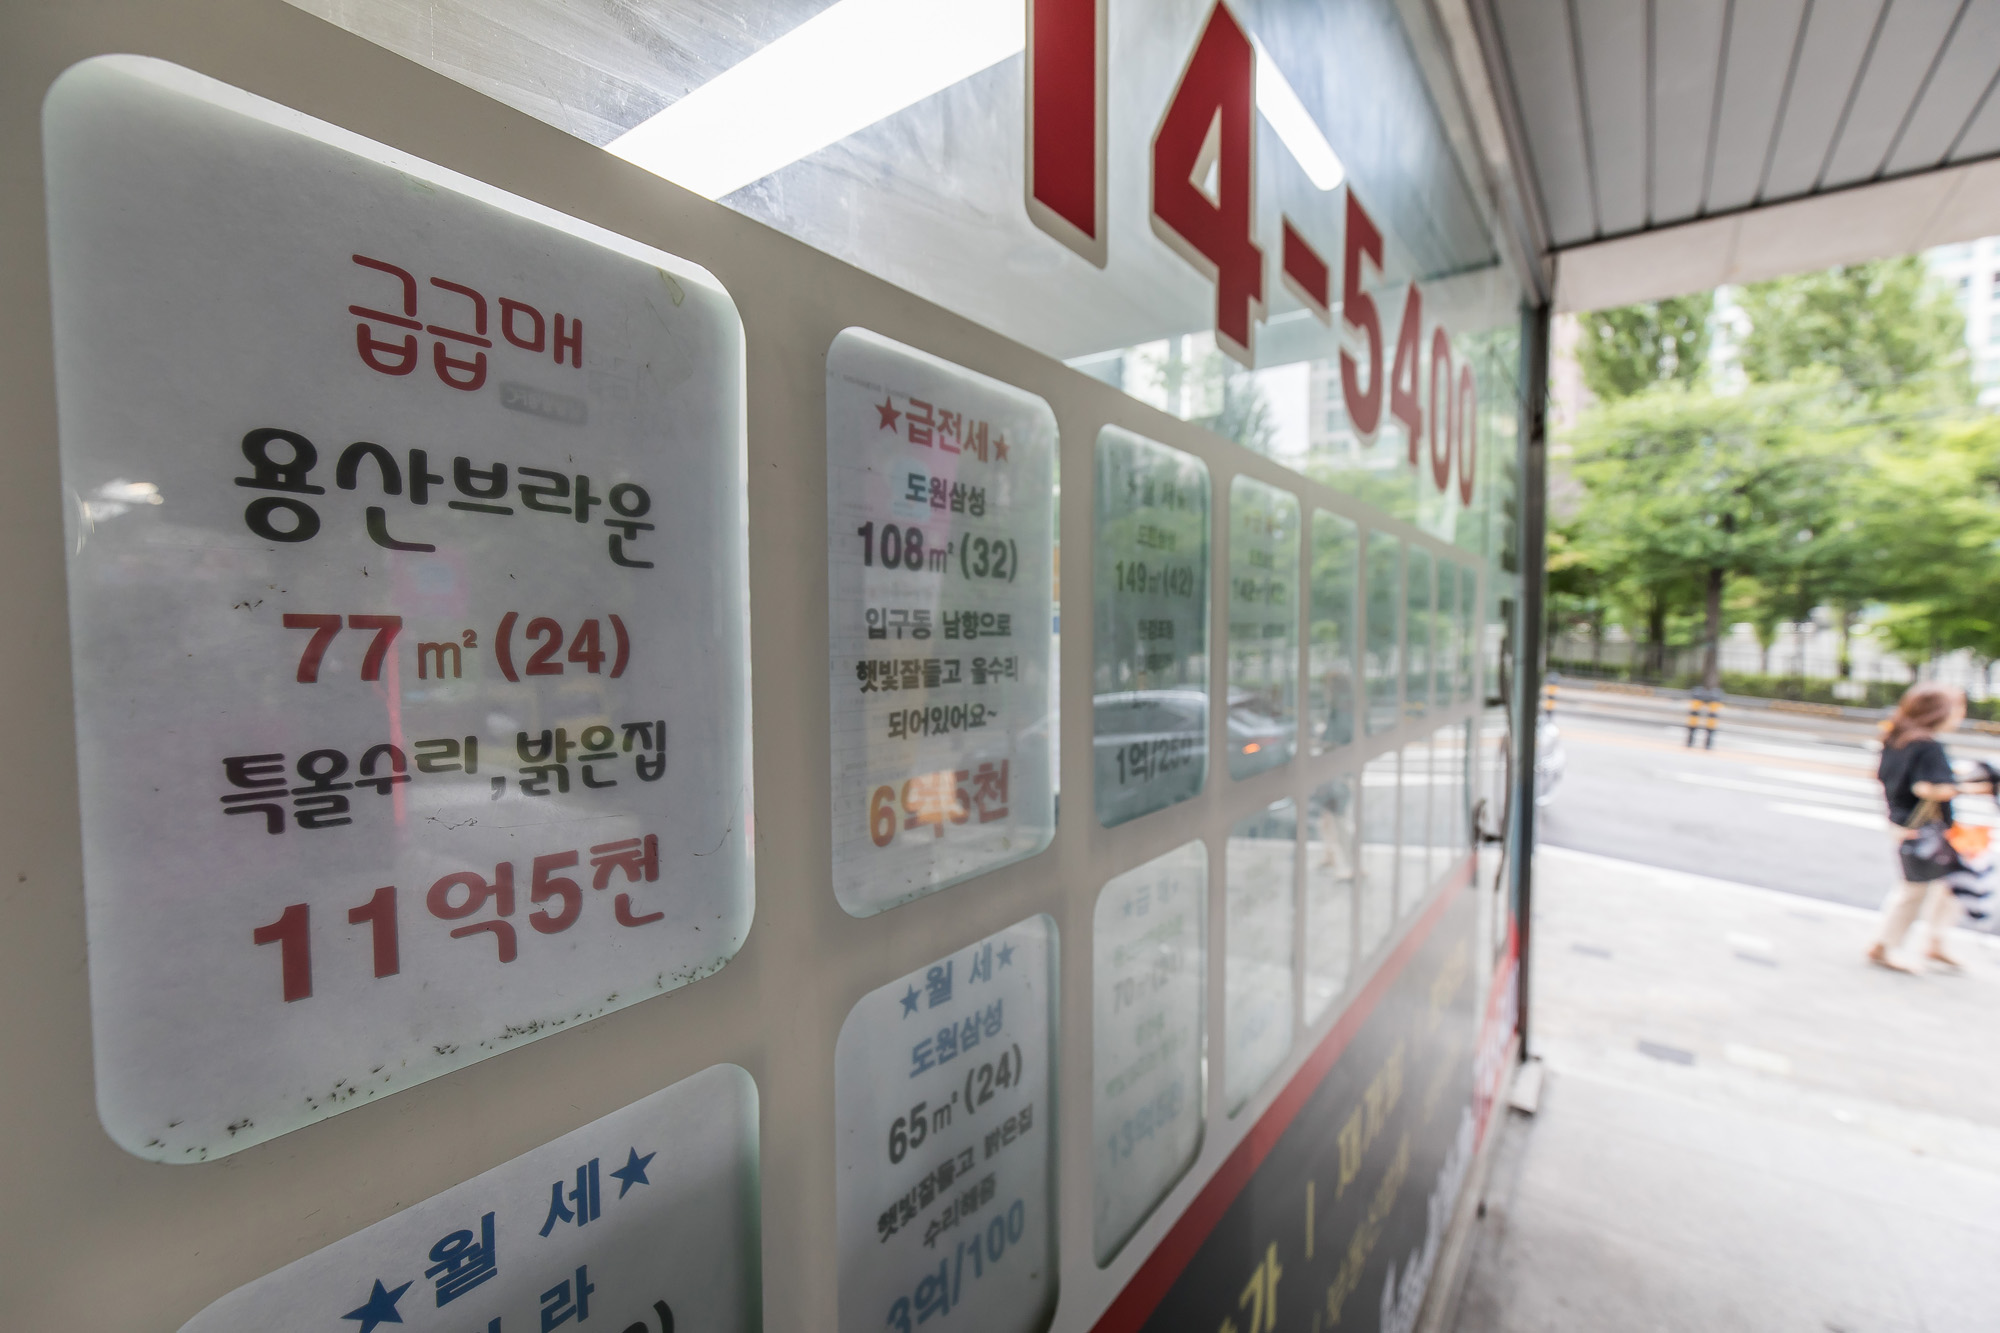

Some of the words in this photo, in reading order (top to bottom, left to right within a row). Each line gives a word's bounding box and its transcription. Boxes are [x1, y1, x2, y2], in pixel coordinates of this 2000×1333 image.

[348, 253, 584, 392] 급급매
[905, 397, 989, 464] 급전세
[234, 427, 656, 569] 용산브라운
[905, 472, 986, 517] 도원삼성
[865, 607, 933, 640] 입구동
[942, 609, 1012, 640] 남향으로
[856, 658, 962, 693] 햇빛잘들고
[970, 655, 1019, 685] 올수리
[887, 702, 998, 741] 되어있어요~
[869, 758, 1009, 848] 6억5천
[252, 833, 666, 1003] 11억5천
[925, 960, 953, 1010] 월
[968, 942, 993, 985] 세
[909, 997, 1004, 1080] 도원삼성
[423, 1210, 498, 1309] 월
[537, 1156, 601, 1239] 세
[877, 1145, 976, 1244] 햇빛잘들고
[886, 1198, 1025, 1333] 3억/100
